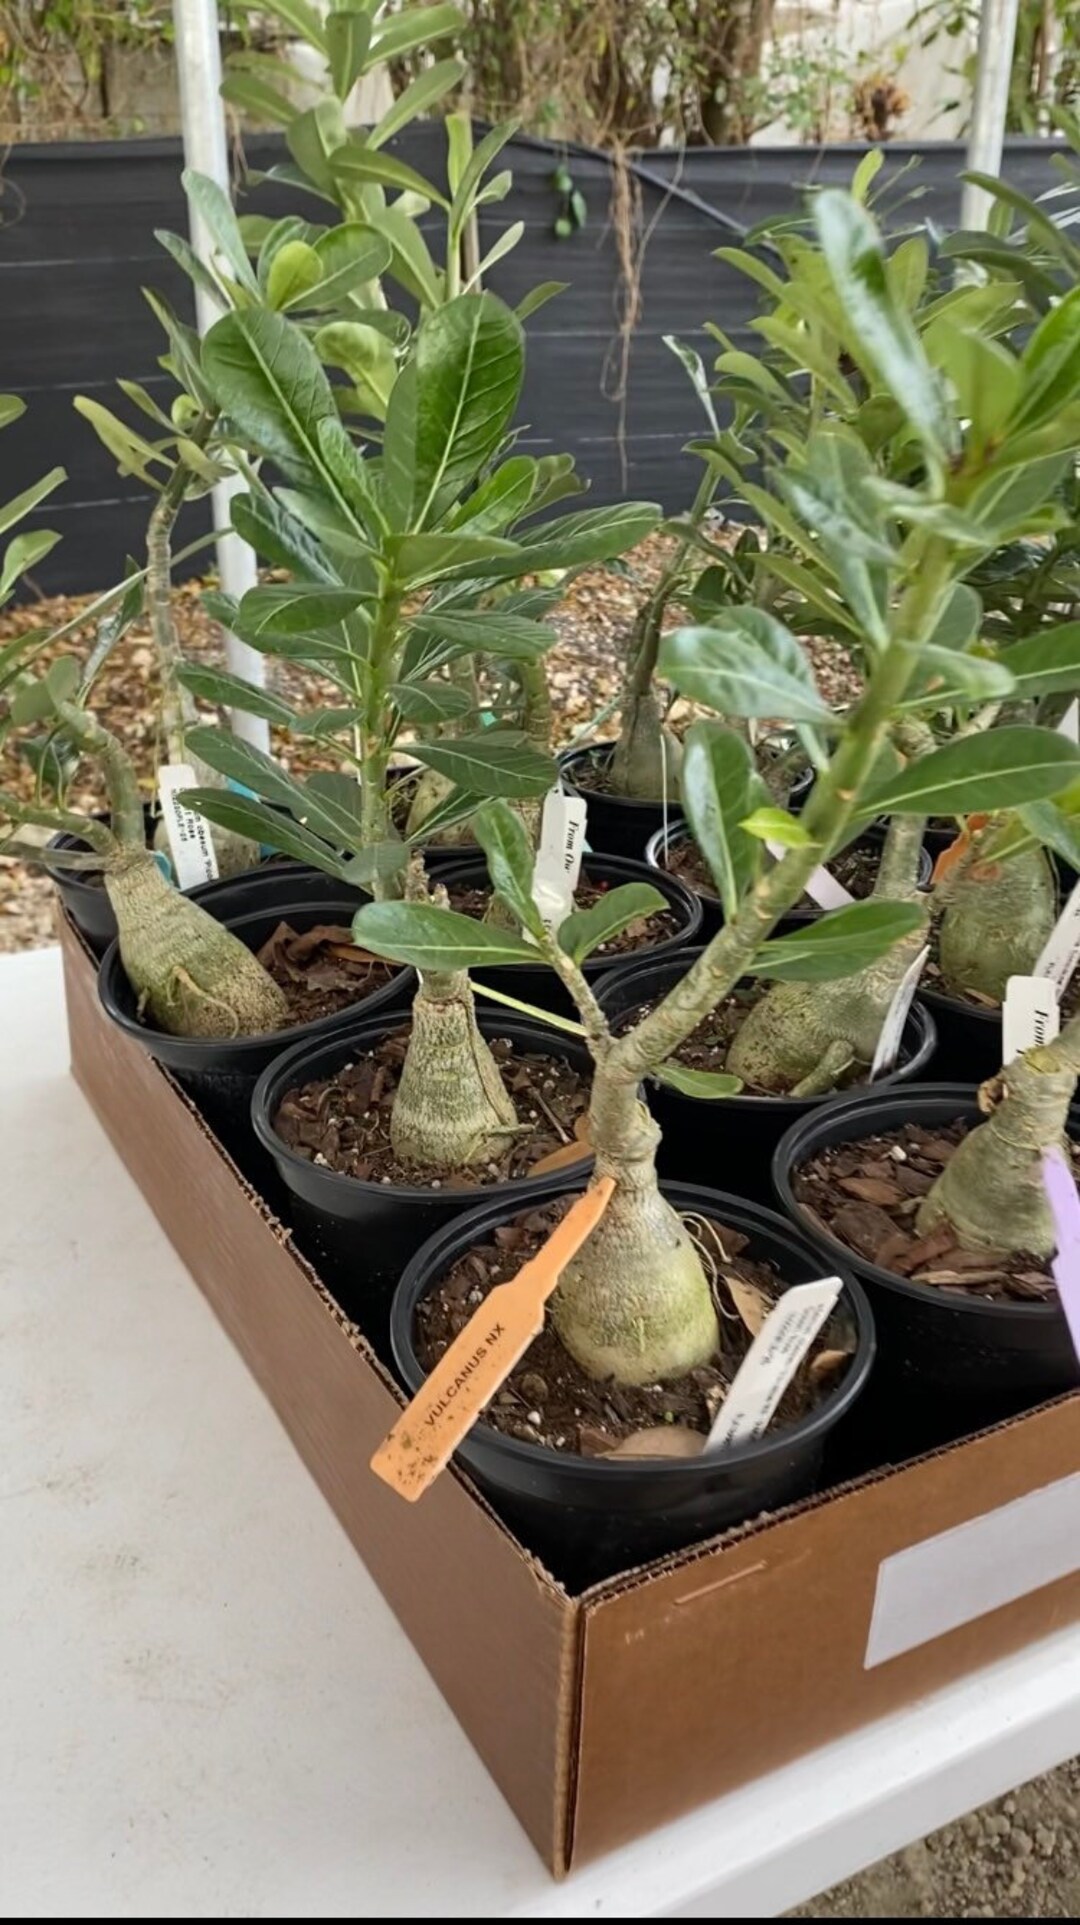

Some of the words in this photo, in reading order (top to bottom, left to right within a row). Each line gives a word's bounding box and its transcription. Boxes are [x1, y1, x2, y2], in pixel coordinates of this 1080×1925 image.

[187, 818, 196, 839] Rose
[564, 819, 579, 850] From
[424, 1346, 488, 1427] VULCANUS
[484, 1322, 506, 1346] NX
